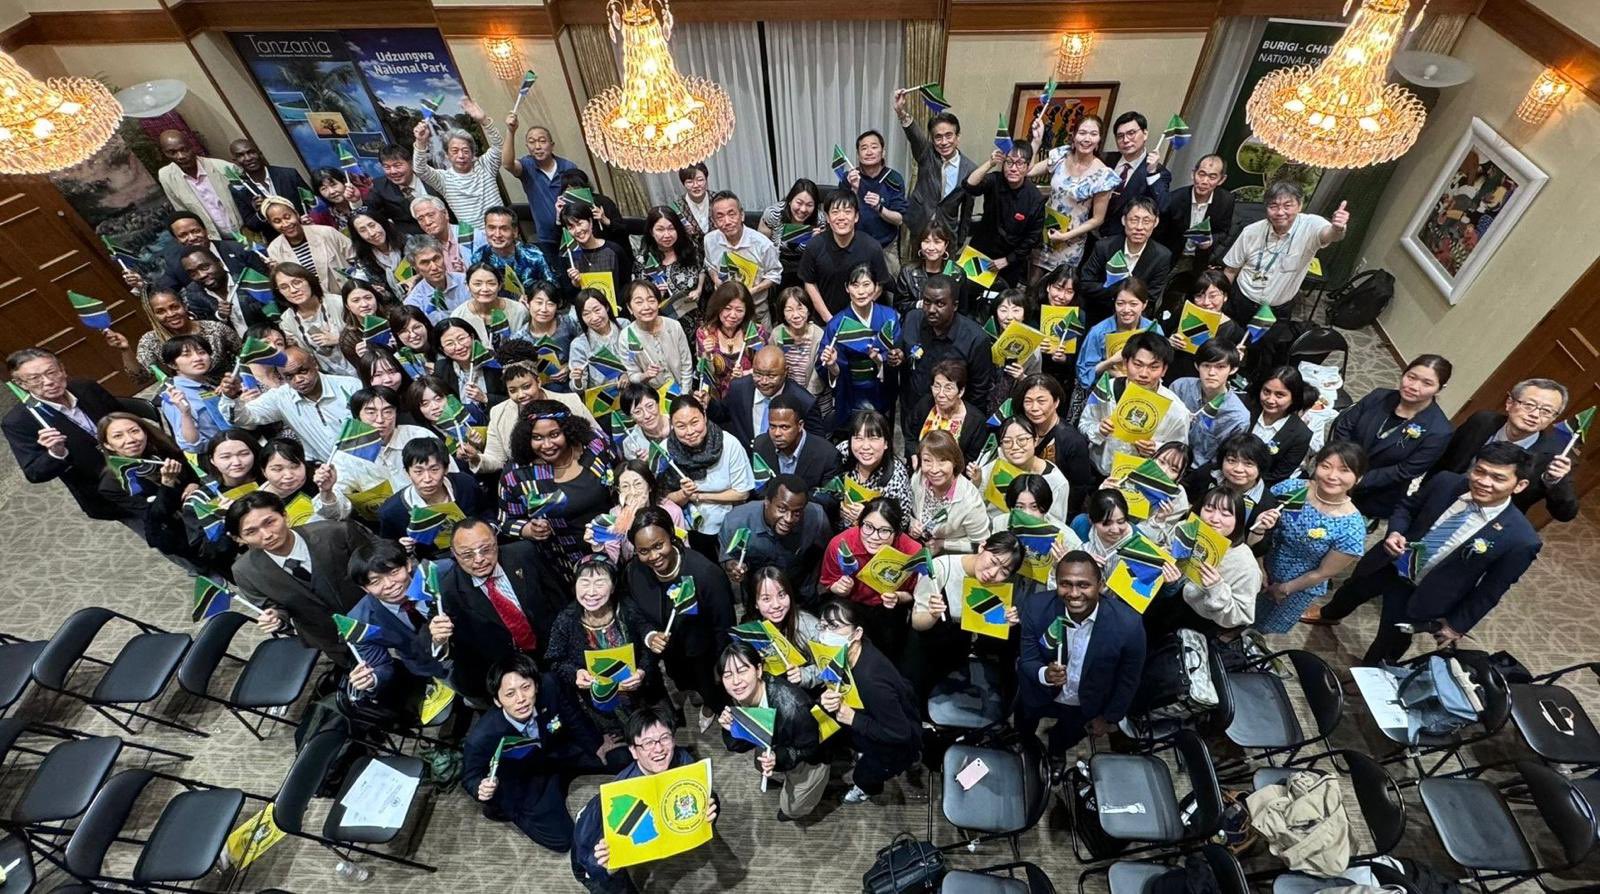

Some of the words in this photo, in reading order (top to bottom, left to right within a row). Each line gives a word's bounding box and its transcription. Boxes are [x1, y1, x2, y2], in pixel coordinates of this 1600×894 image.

[244, 34, 332, 54] Tanzania
[1262, 40, 1299, 51] BURIGI
[1305, 44, 1334, 55] CHAT
[375, 51, 435, 62] Udzungwa
[1258, 53, 1306, 65] NATIONAL
[373, 63, 420, 75] National
[421, 62, 449, 73] Park
